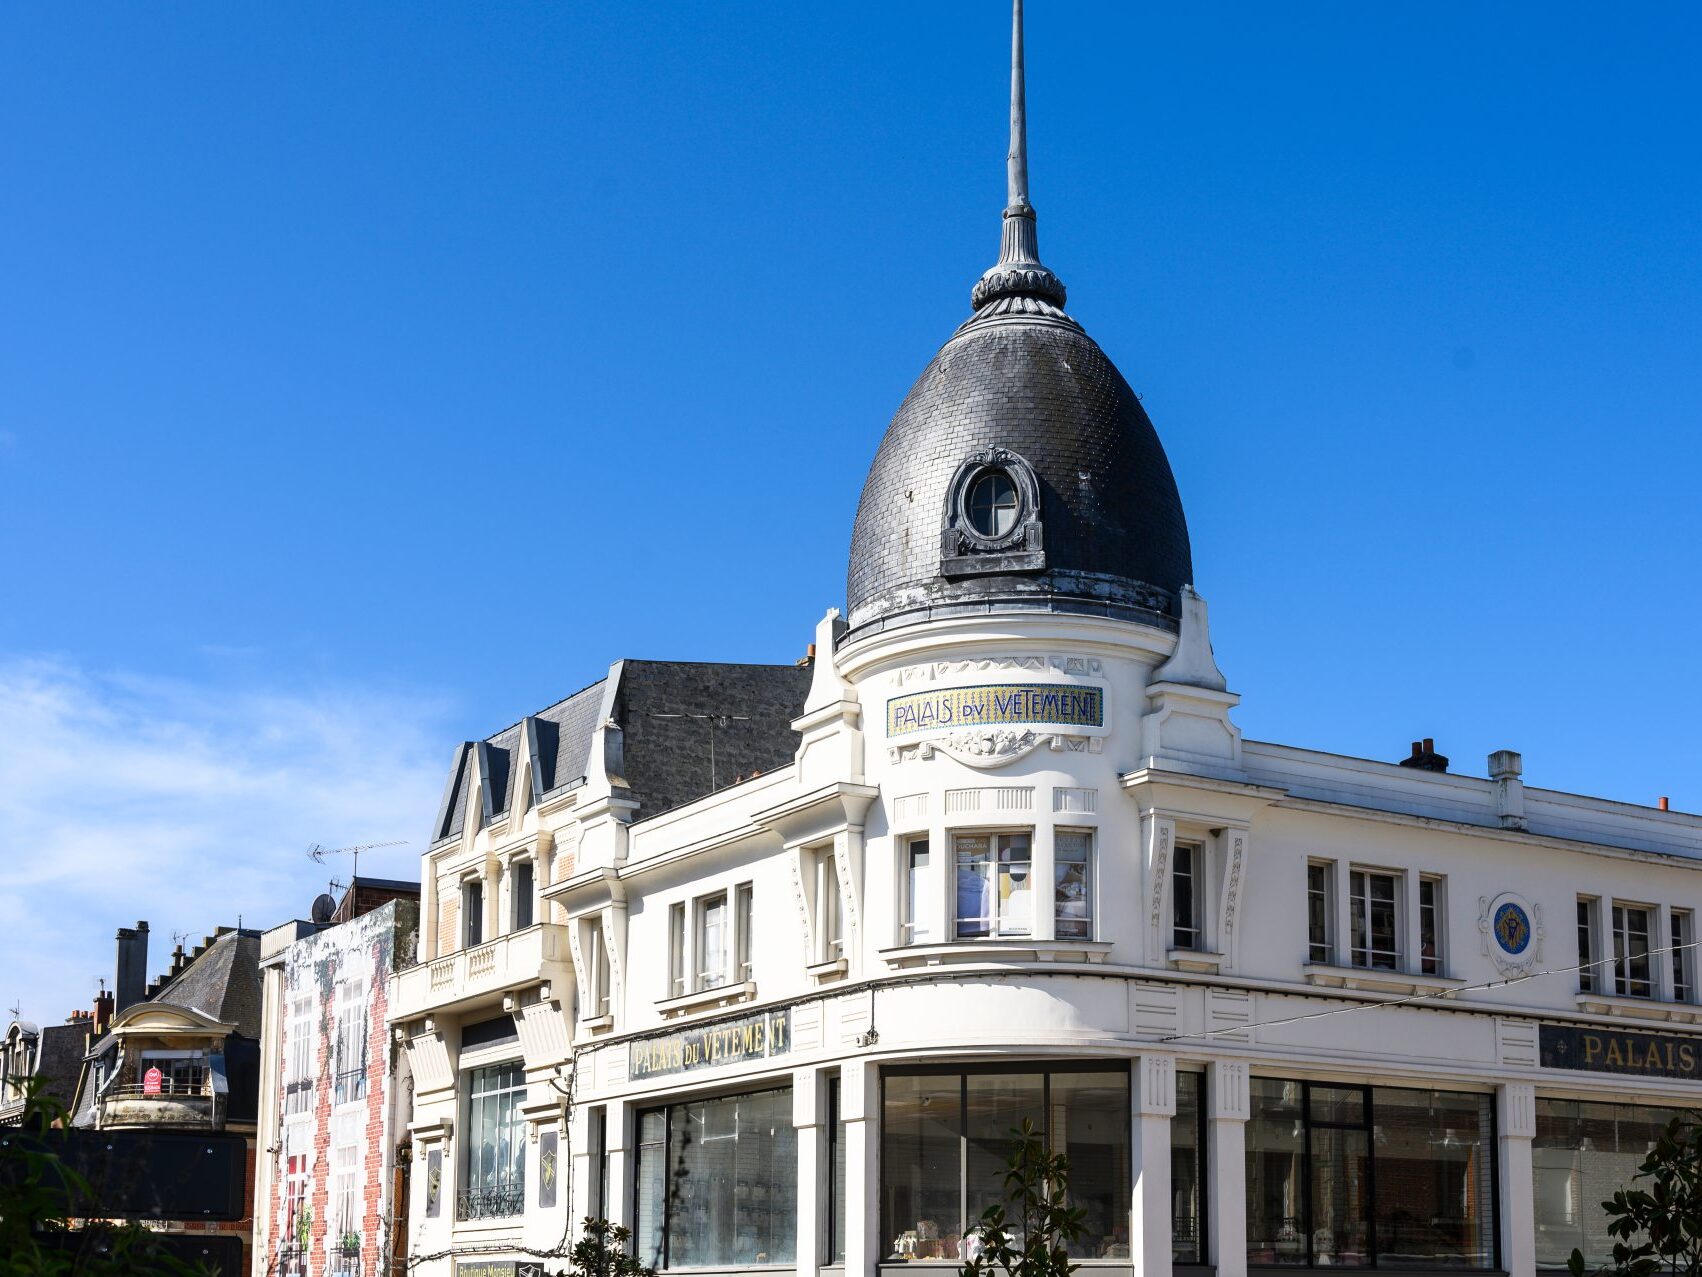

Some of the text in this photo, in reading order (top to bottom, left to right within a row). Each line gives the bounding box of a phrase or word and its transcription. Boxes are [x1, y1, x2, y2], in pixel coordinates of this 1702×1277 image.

[894, 698, 952, 728] PALAIS
[993, 689, 1097, 722] VETEMENT
[634, 1039, 682, 1075] PALAIS
[684, 1044, 700, 1065] DU
[1583, 1035, 1696, 1072] PALAIS
[488, 1263, 516, 1277] Monsieu
